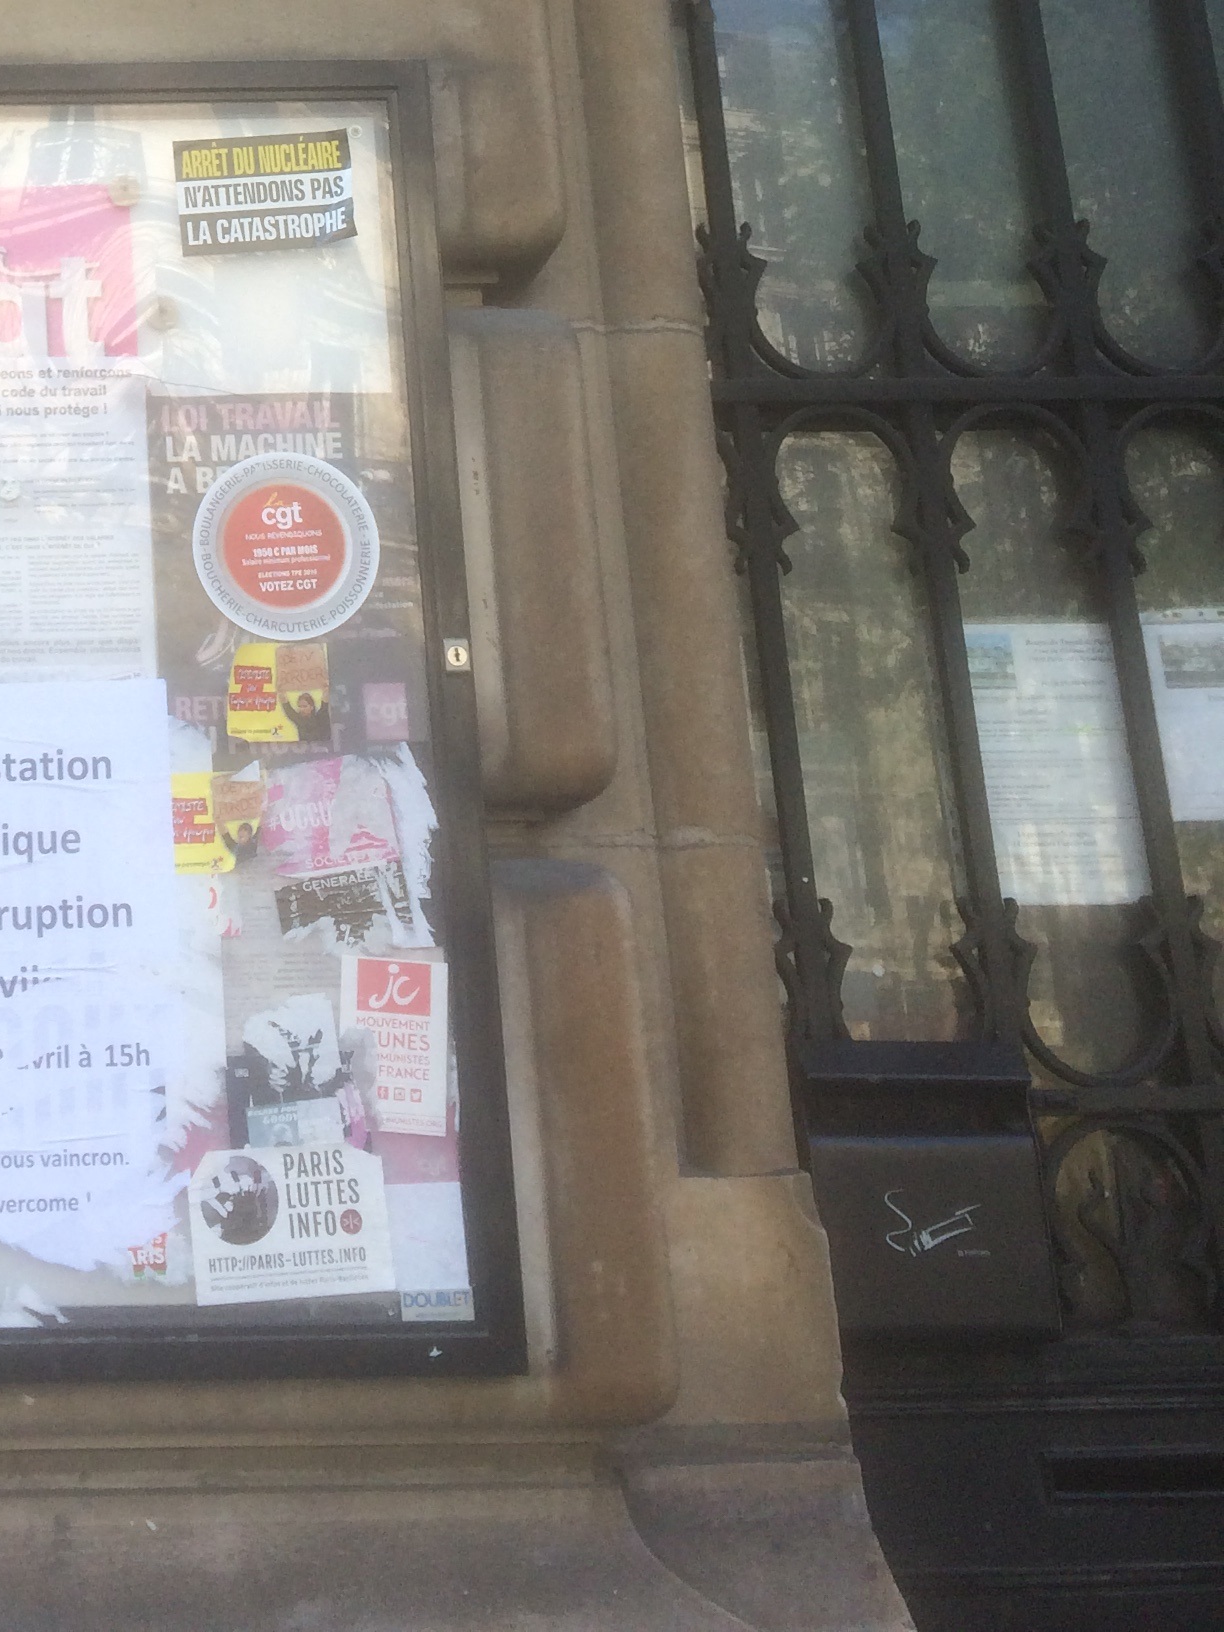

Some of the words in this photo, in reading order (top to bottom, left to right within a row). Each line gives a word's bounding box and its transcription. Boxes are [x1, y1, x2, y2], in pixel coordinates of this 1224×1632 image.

[182, 142, 229, 179] ARRÊT
[233, 147, 254, 175] DU
[259, 137, 342, 174] NUCLÉAIRE
[184, 178, 306, 209] N'ATTENDONS
[310, 175, 344, 202] PAS
[187, 221, 212, 246] LA
[217, 206, 347, 245] CATASTROPHE
[38, 368, 53, 380] et
[57, 366, 133, 381] renforçons
[2, 386, 36, 398] code
[40, 386, 57, 397] du
[62, 384, 107, 397] travail
[6, 405, 40, 417] nous
[44, 403, 99, 419] protège
[219, 400, 340, 430] TRAVAIL
[165, 436, 201, 462] LA
[210, 432, 343, 462] MACHINE
[262, 502, 303, 529] cgt
[260, 581, 294, 592] VOTEZ
[296, 579, 318, 590] CGT
[369, 963, 421, 1010] jc
[356, 1015, 431, 1033] MOUVEMENT
[15, 1044, 69, 1070] vril
[78, 1044, 91, 1068] à
[104, 1043, 151, 1068] 15h
[378, 1065, 431, 1082] FRANCE
[40, 1149, 130, 1169] vaincron.
[283, 1149, 346, 1179] PARIS
[286, 1178, 361, 1208] LUTTES
[289, 1211, 337, 1239] INFO
[208, 1247, 368, 1274] HTTP://PARIS-LUTTES.INFO
[402, 1290, 470, 1308] DOUBLET
